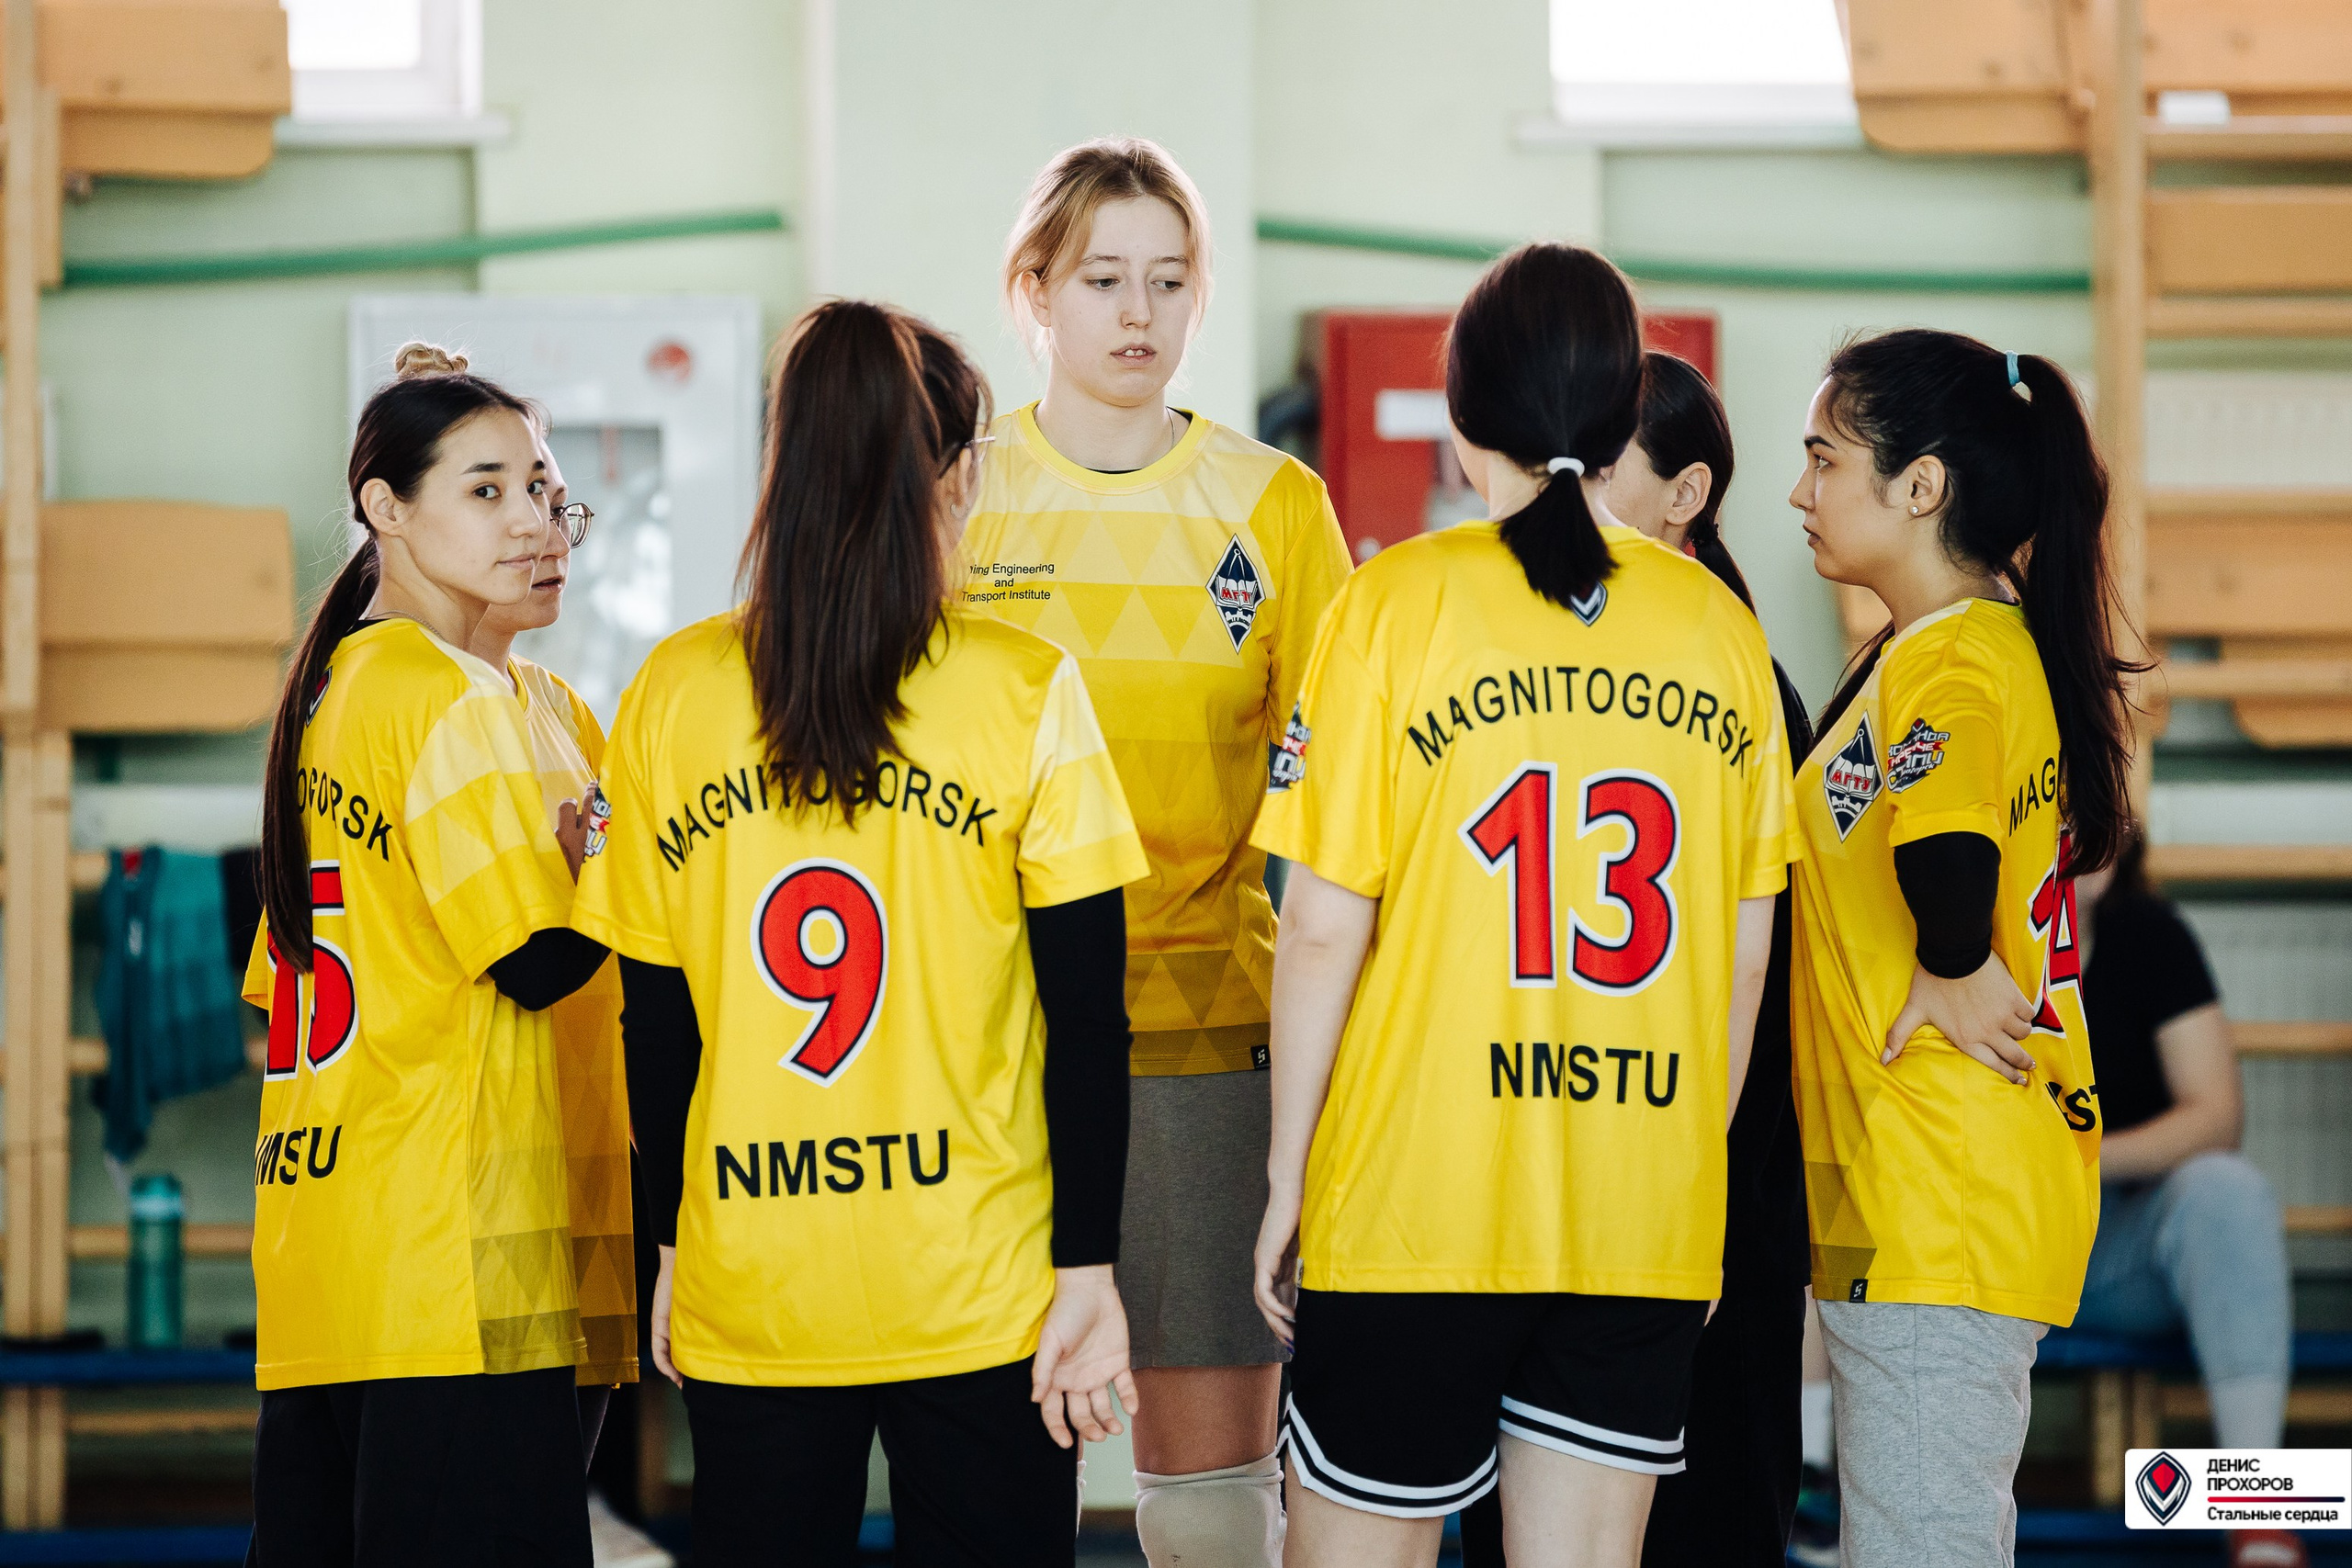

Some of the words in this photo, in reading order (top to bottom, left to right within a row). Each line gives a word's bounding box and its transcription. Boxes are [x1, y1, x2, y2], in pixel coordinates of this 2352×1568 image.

[962, 591, 1006, 604] Transport
[1009, 589, 1051, 600] Institute
[991, 563, 1055, 577] Engineering
[994, 578, 1014, 588] and
[1408, 667, 1753, 778] MAGNITOGORSK
[1831, 770, 1871, 792] МГТУ
[1458, 761, 1681, 997] 13
[750, 857, 889, 1089] 9
[1490, 1042, 1679, 1109] NMSTU
[715, 1129, 949, 1201] NMSTU
